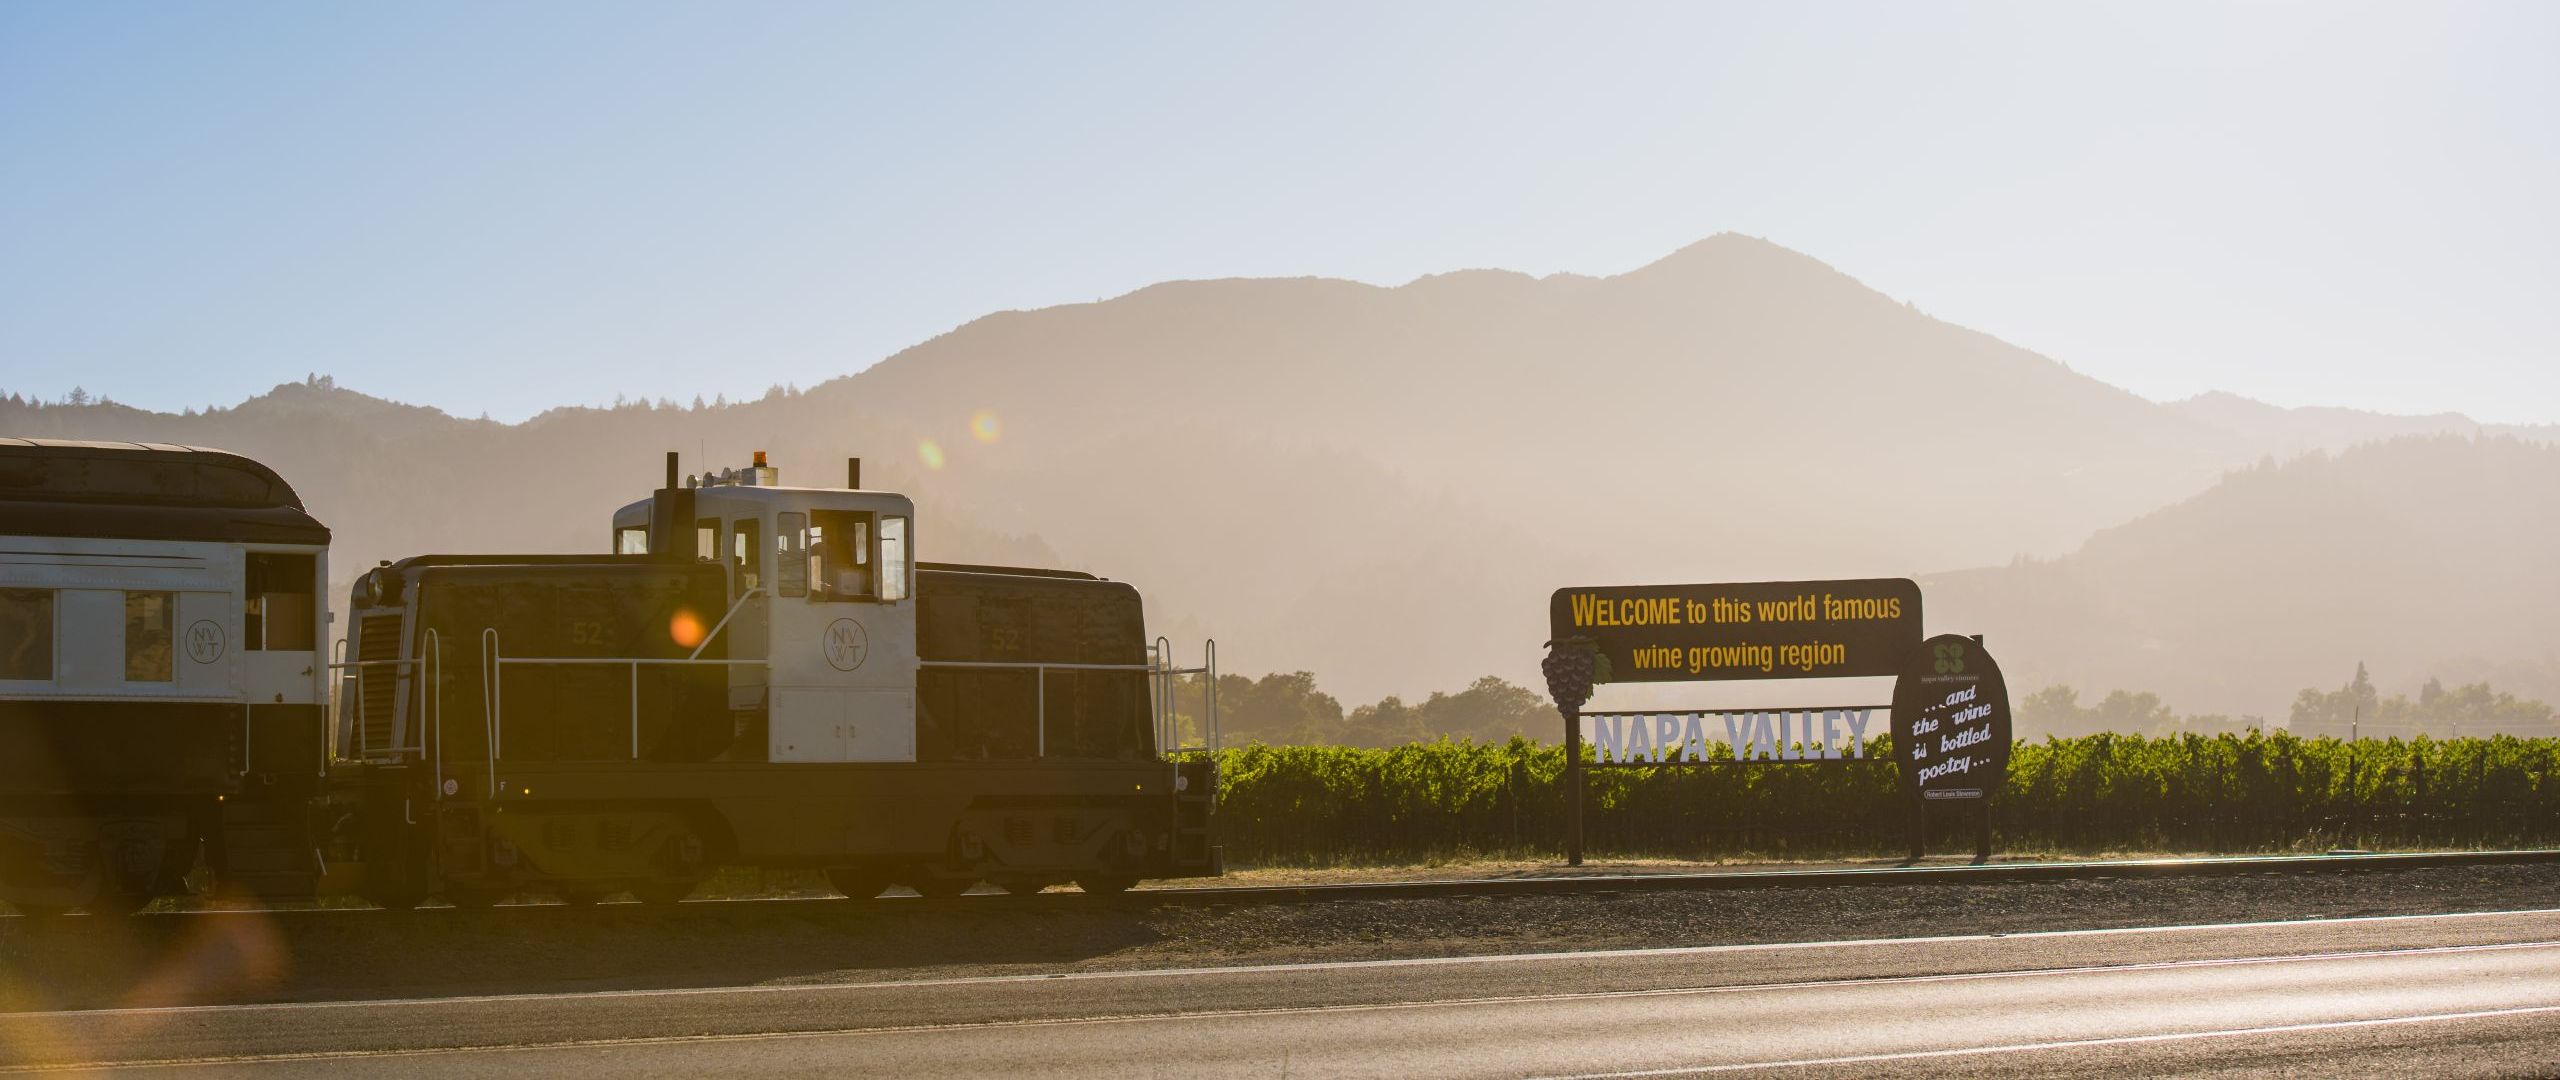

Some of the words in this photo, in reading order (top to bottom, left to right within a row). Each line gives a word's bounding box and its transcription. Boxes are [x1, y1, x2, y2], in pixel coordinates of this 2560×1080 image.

[1571, 593, 1681, 626] WELCOME
[1686, 599, 1706, 624] to
[1712, 597, 1751, 623] this
[1757, 594, 1816, 622] world
[1823, 593, 1901, 620] famous
[1633, 644, 1682, 669] wine
[1688, 641, 1773, 674] growing
[1780, 640, 1845, 671] region
[1594, 712, 1709, 764] NAPA
[1722, 708, 1872, 762] VALLEY
[1912, 718, 1939, 736] the
[1952, 703, 1992, 725] wine
[1912, 743, 1927, 760] is
[1940, 723, 1992, 753] bottled
